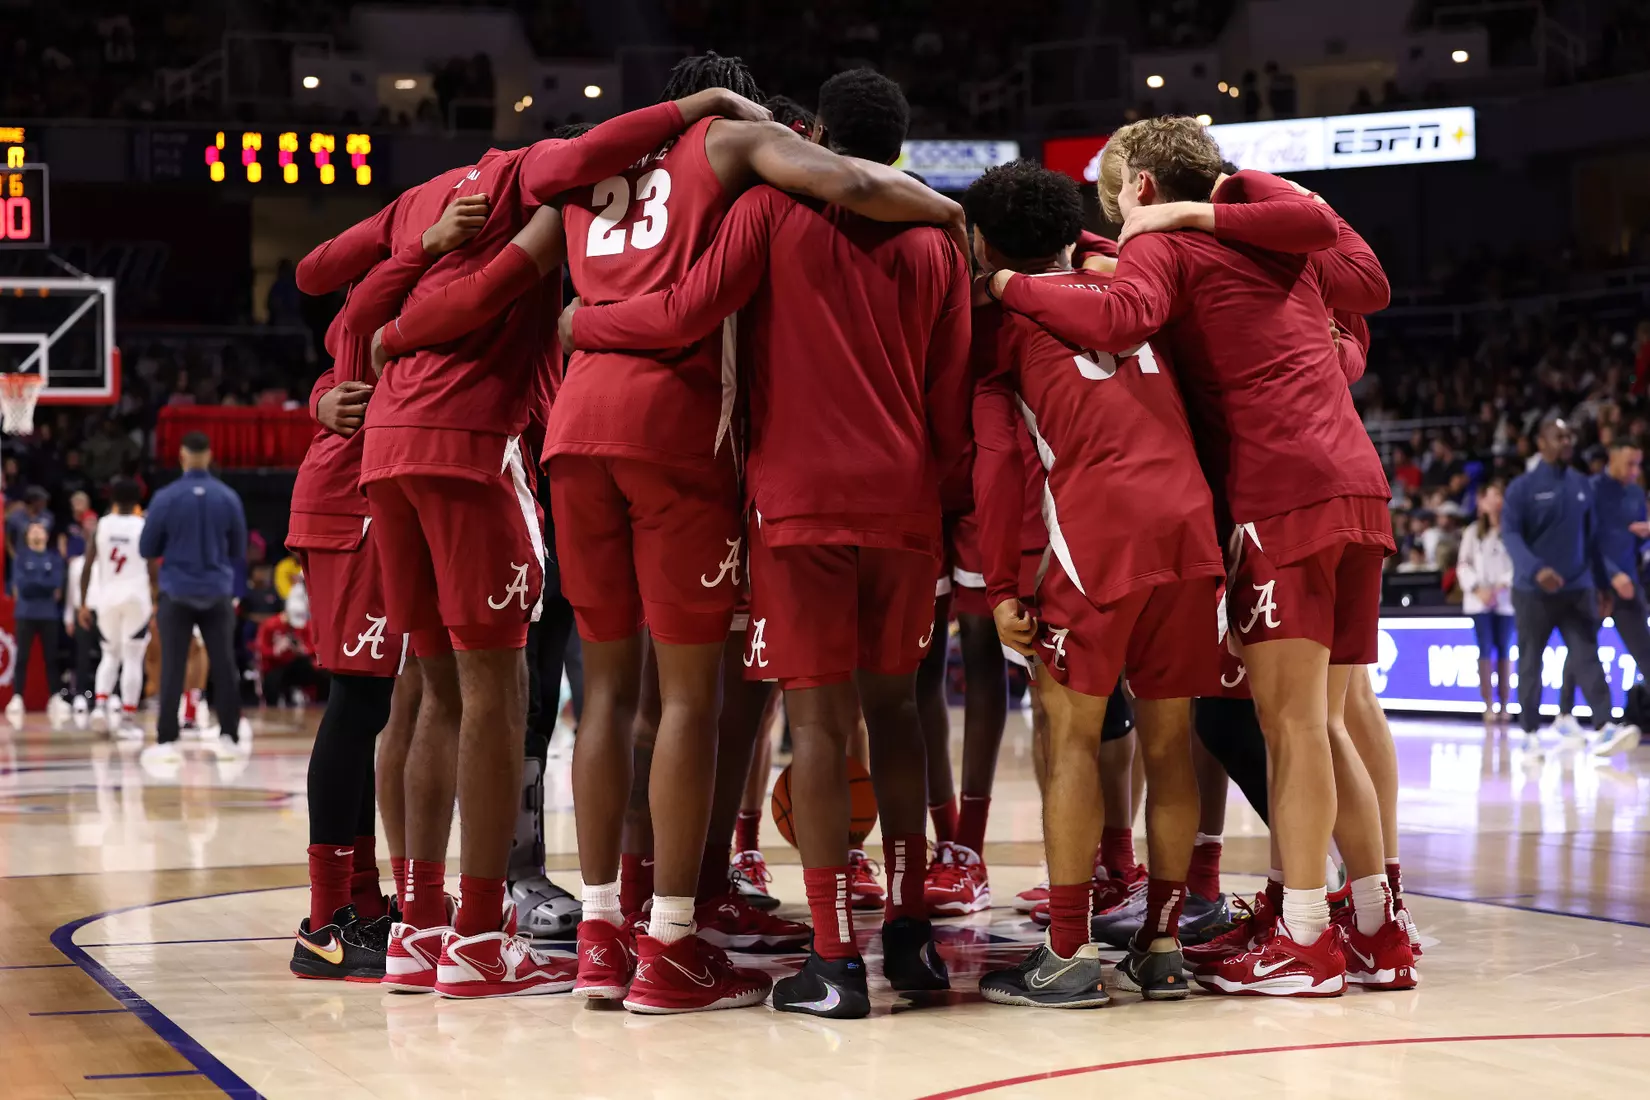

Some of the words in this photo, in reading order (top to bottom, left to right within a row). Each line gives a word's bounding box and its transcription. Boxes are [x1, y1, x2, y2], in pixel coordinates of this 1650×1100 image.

[586, 168, 671, 257] 23
[110, 547, 127, 574] 4
[701, 536, 741, 588] A
[488, 561, 529, 610] A
[1239, 579, 1281, 634] A
[343, 612, 387, 660] A
[743, 618, 769, 667] A
